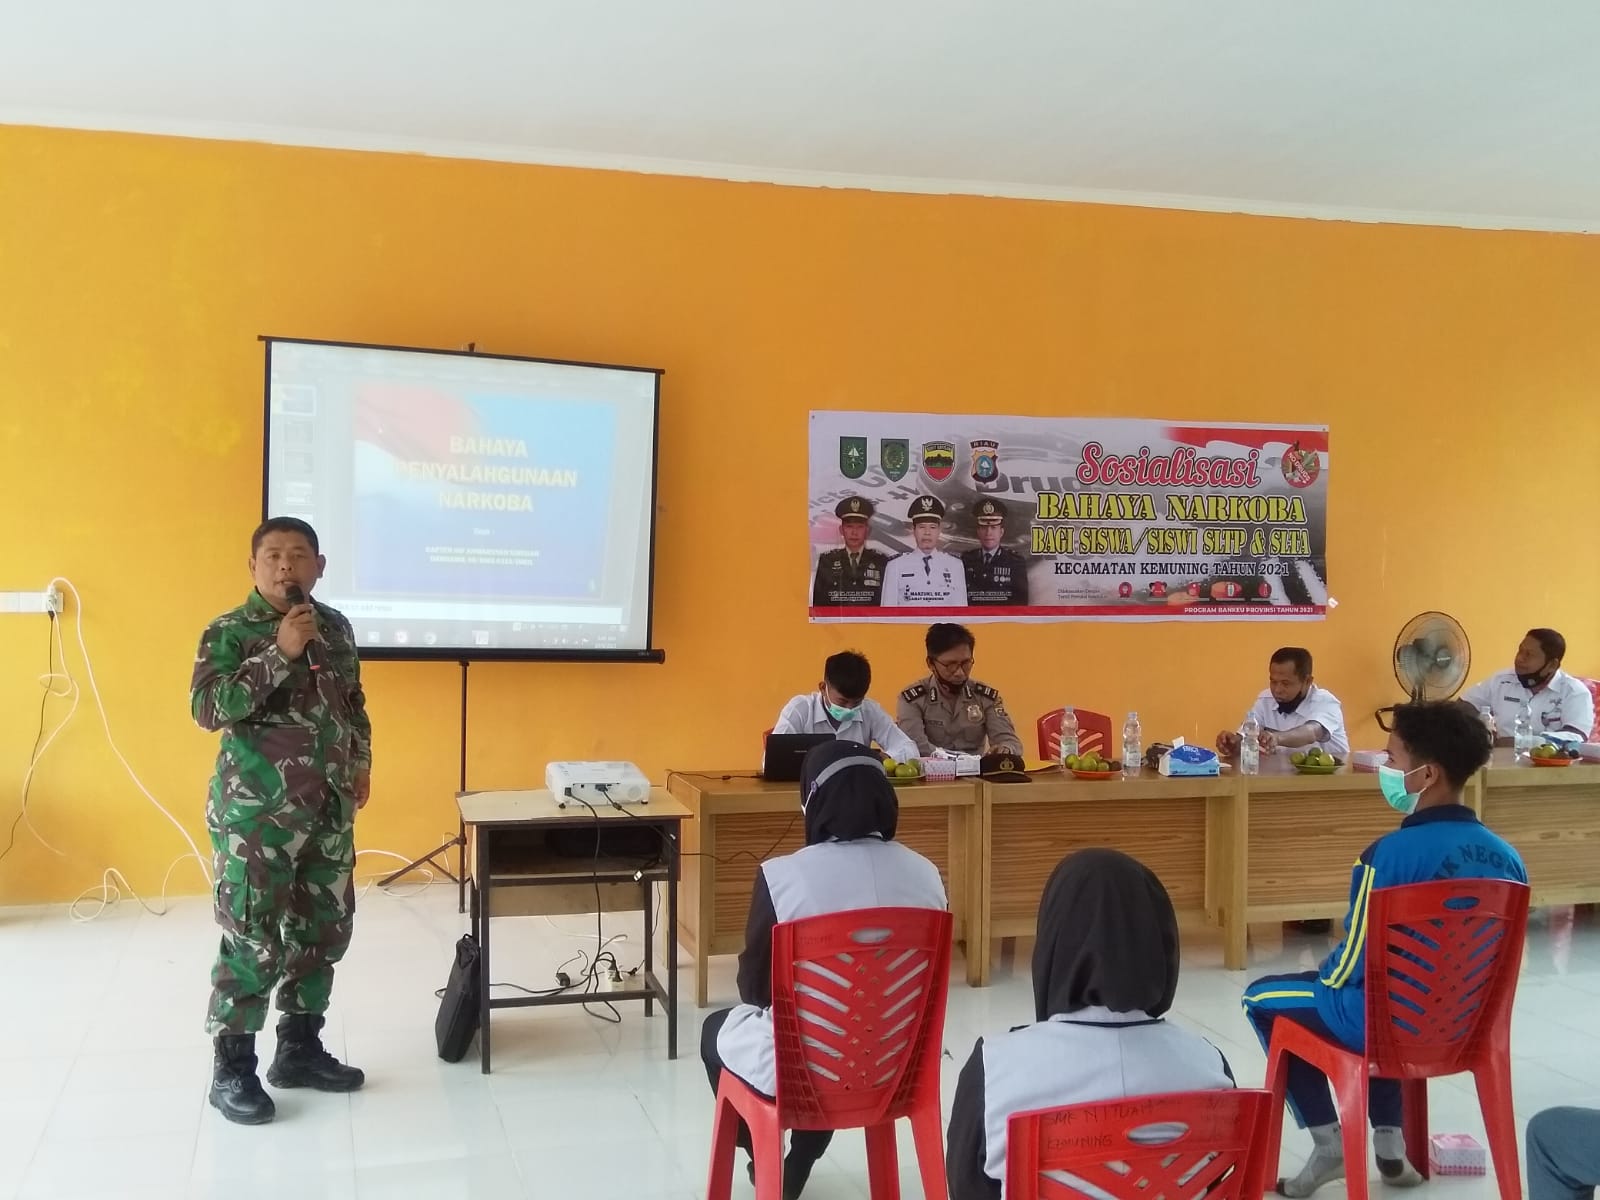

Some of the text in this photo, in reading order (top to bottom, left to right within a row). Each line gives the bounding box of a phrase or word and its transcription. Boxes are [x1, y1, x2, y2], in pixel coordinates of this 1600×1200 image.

[449, 434, 528, 458] BAHAYA
[973, 440, 997, 448] RIAU
[394, 460, 578, 488] PENYALAHGUNAAN
[1076, 441, 1262, 487] Sosialisasi
[439, 491, 534, 512] NARKOBA
[1037, 492, 1308, 523] BAHAYA NARKOBA
[1031, 526, 1075, 554] BAGI
[1202, 528, 1247, 555] SLTP
[1251, 528, 1266, 555] &
[1269, 529, 1311, 555] SLTA
[1054, 562, 1289, 576] KECAMATAN KEMUNING TAHUN 2021
